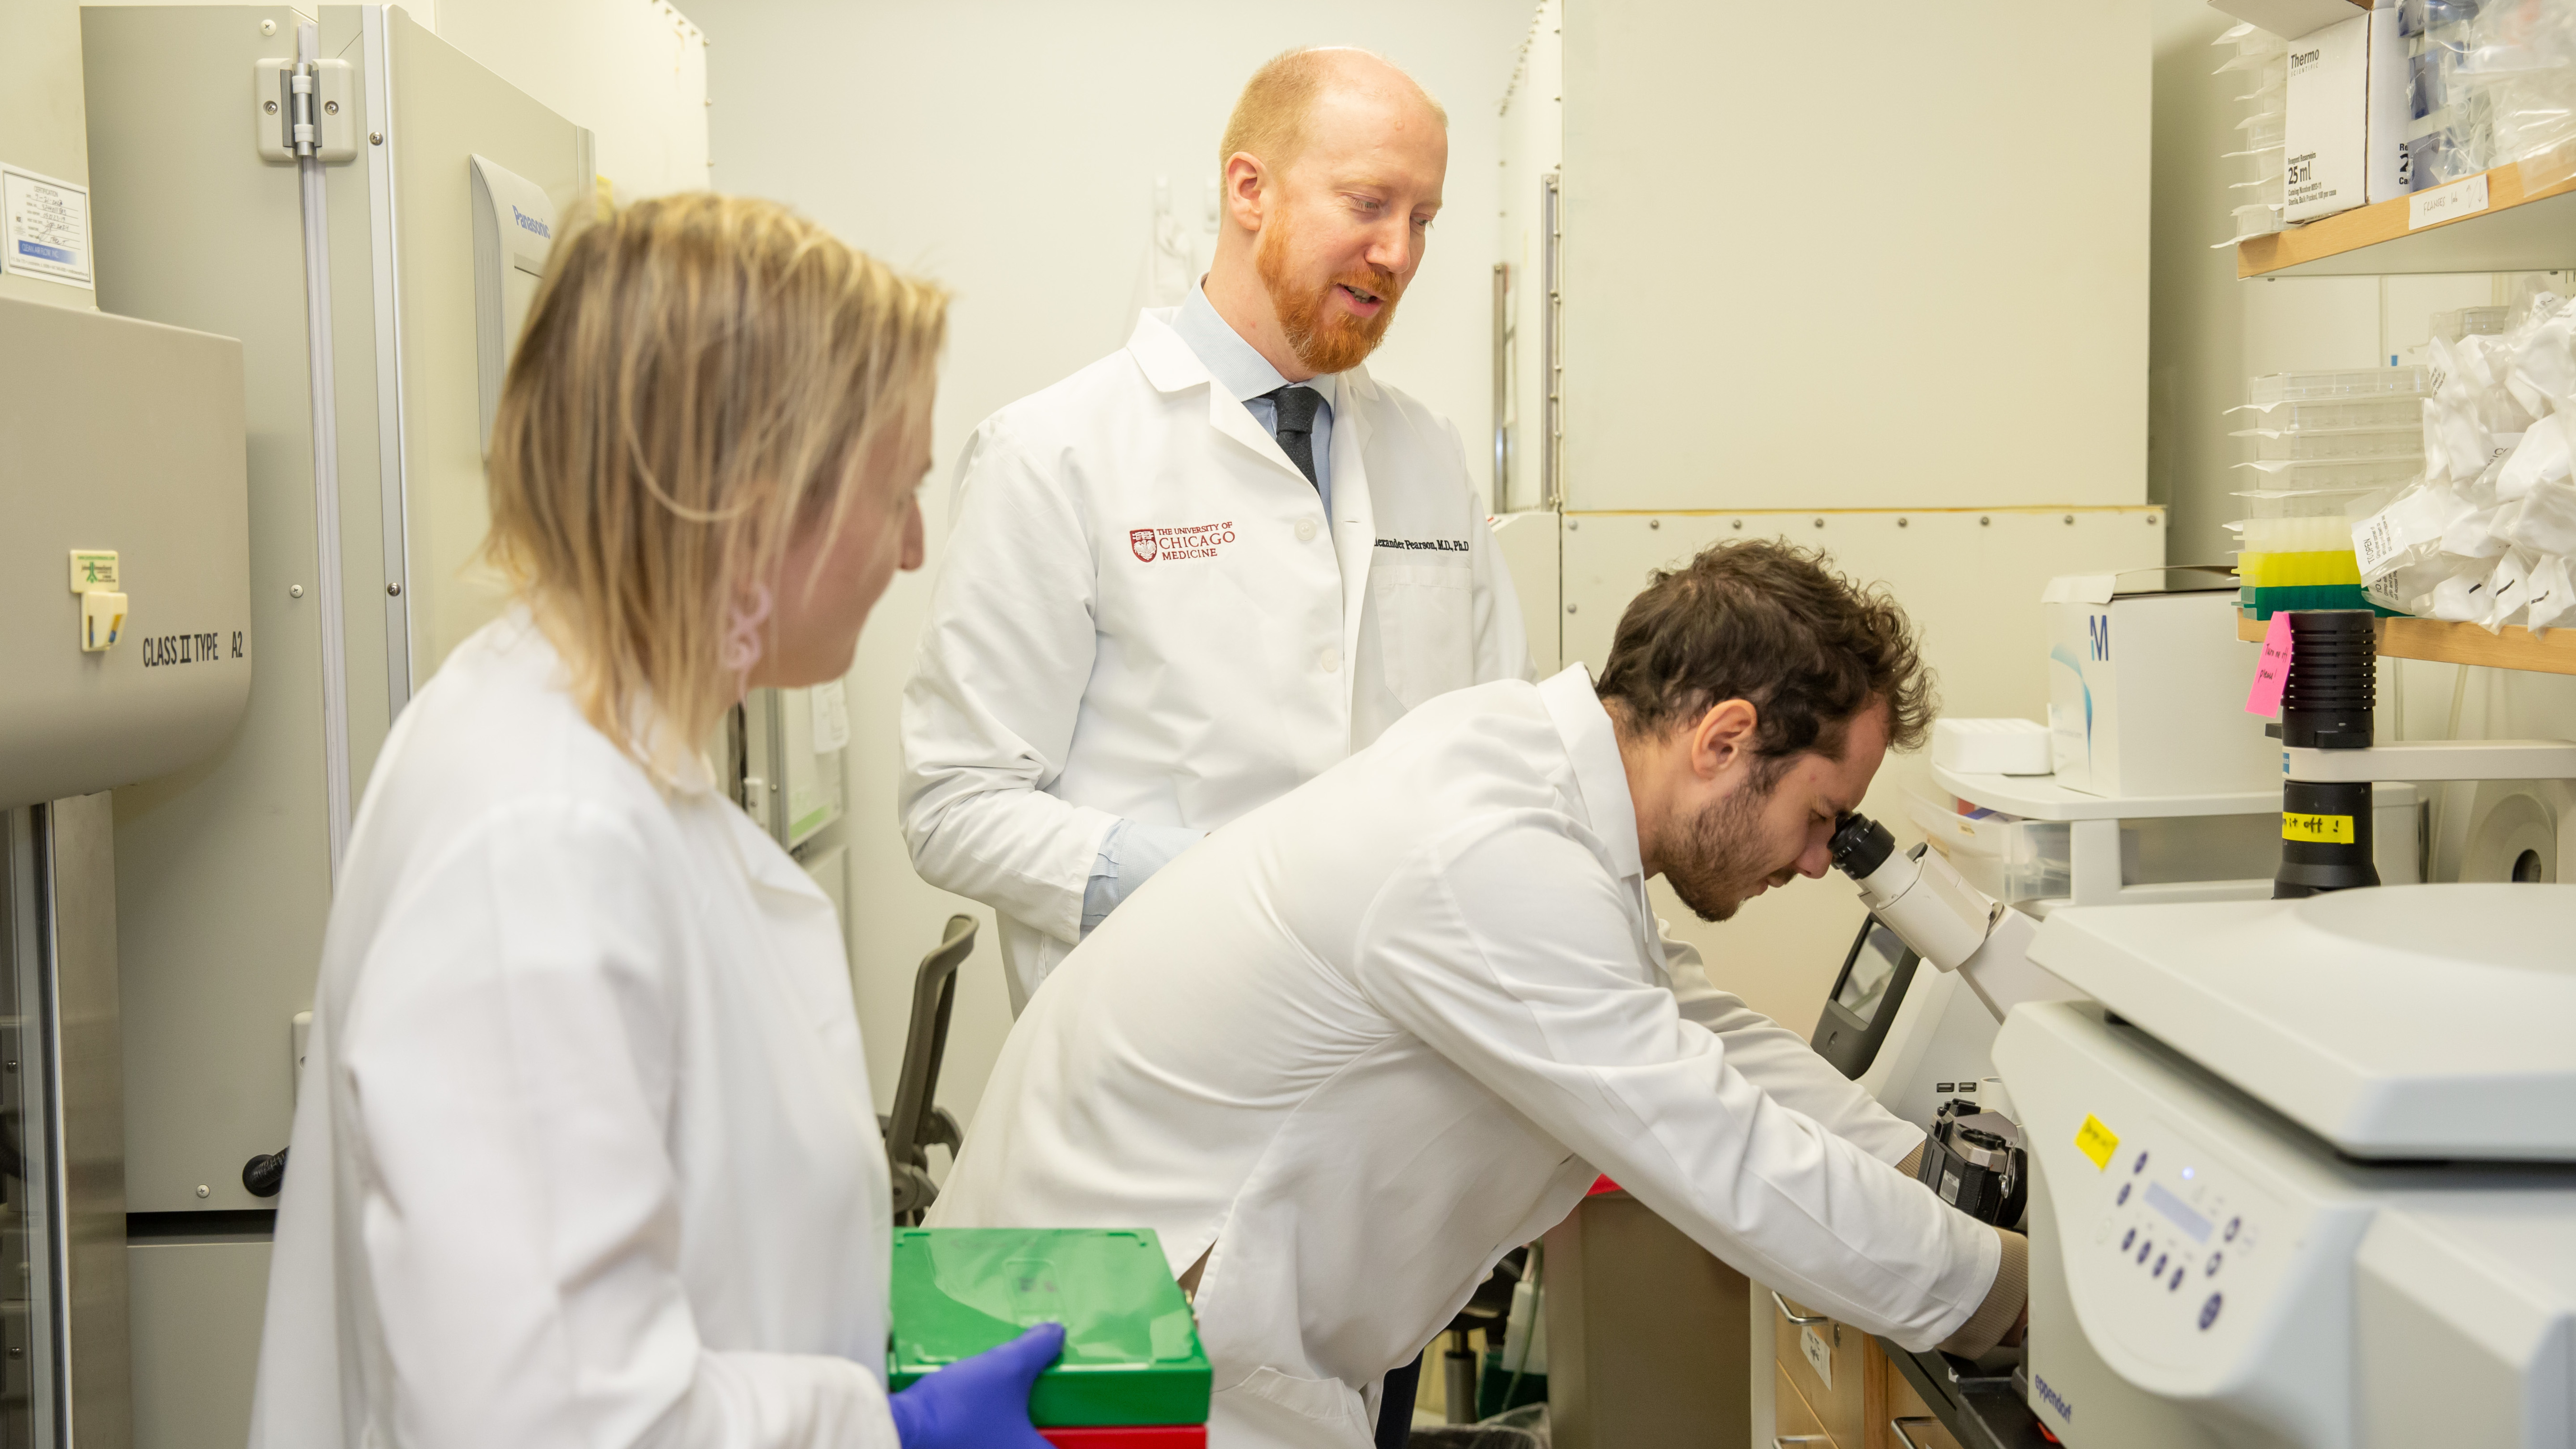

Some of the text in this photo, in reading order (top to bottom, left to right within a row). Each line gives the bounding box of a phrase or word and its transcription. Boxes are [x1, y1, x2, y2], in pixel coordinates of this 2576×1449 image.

[2291, 49, 2319, 69] Thermo
[2291, 62, 2318, 77] SCIENTIFIC
[2288, 151, 2316, 165] Reagent Reservoirs
[2288, 161, 2311, 185] 25 ml
[34, 186, 58, 197] CERTIFICATION
[2299, 185, 2311, 194] Number
[512, 205, 551, 240] Panasonic
[21, 244, 34, 254] CLEAN
[1174, 524, 1219, 535] UNIVERSITY
[1221, 521, 1233, 529] OF
[1159, 531, 1236, 549] CHICAGO
[1374, 536, 1405, 549] lexander
[1404, 539, 1437, 551] Pearson,
[2364, 538, 2374, 555] OPEN
[1162, 548, 1217, 561] MEDICINE
[2090, 615, 2109, 661] M
[143, 631, 243, 668] CLASS II TYPE A2
[2265, 643, 2274, 656] Turn
[2275, 650, 2281, 659] me
[2289, 818, 2298, 828] it
[2303, 817, 2323, 834] off
[2035, 1374, 2072, 1425] eppendorf
